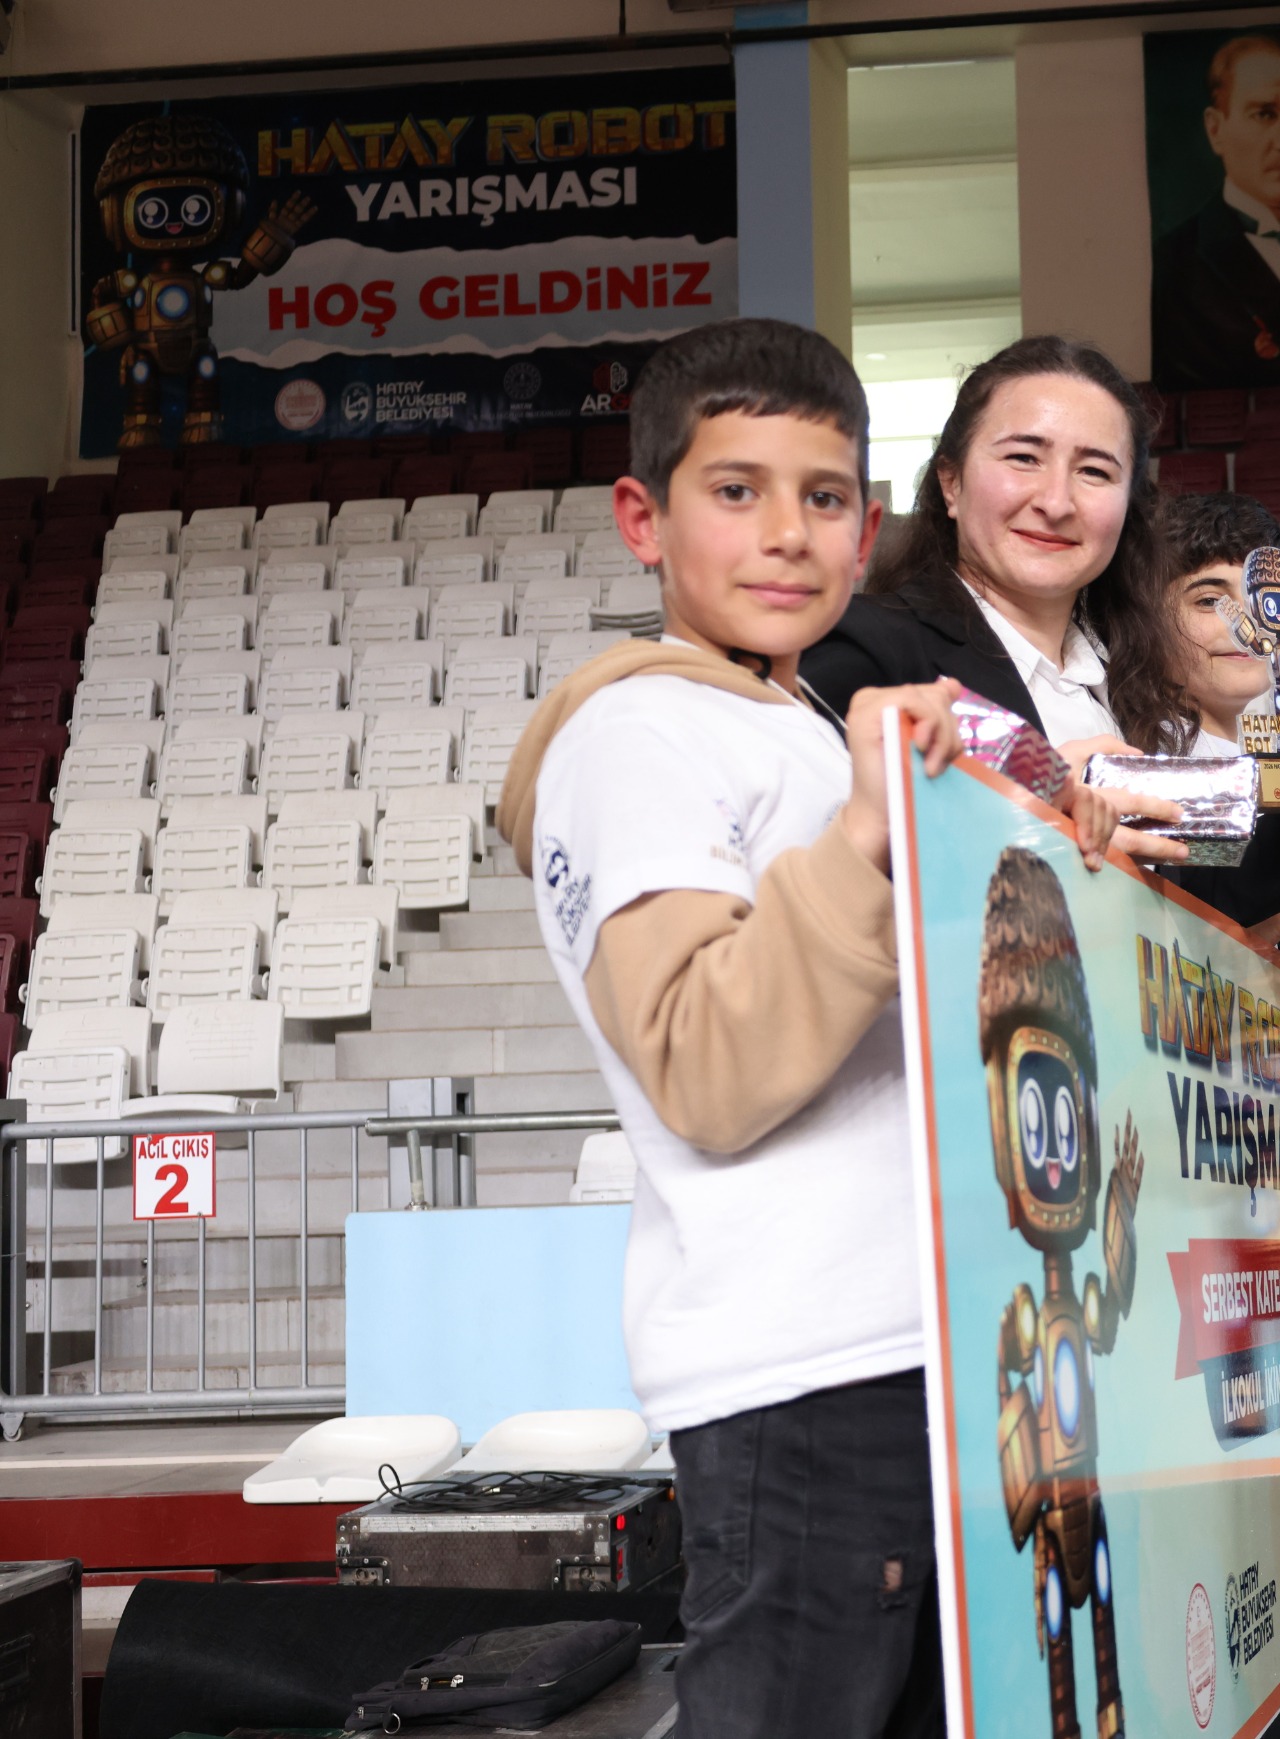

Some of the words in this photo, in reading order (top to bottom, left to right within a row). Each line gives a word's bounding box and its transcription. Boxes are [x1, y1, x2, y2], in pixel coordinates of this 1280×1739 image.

[257, 113, 474, 178] HATAY
[486, 99, 736, 165] ROBOT
[345, 166, 638, 227] YARIŞMASI
[267, 279, 397, 338] HOŞ
[418, 261, 713, 321] GELDİNİZ
[376, 380, 425, 396] HATAY
[580, 393, 631, 411] ARG
[1244, 736, 1271, 753] BOT
[1136, 933, 1235, 1063] HATAY
[172, 1138, 209, 1160] ÇIKIŞ
[153, 1163, 189, 1214] 2
[1201, 1270, 1254, 1324] SERBEST
[1221, 1370, 1265, 1425] İLKOKUL
[1239, 1560, 1259, 1602] HATAY
